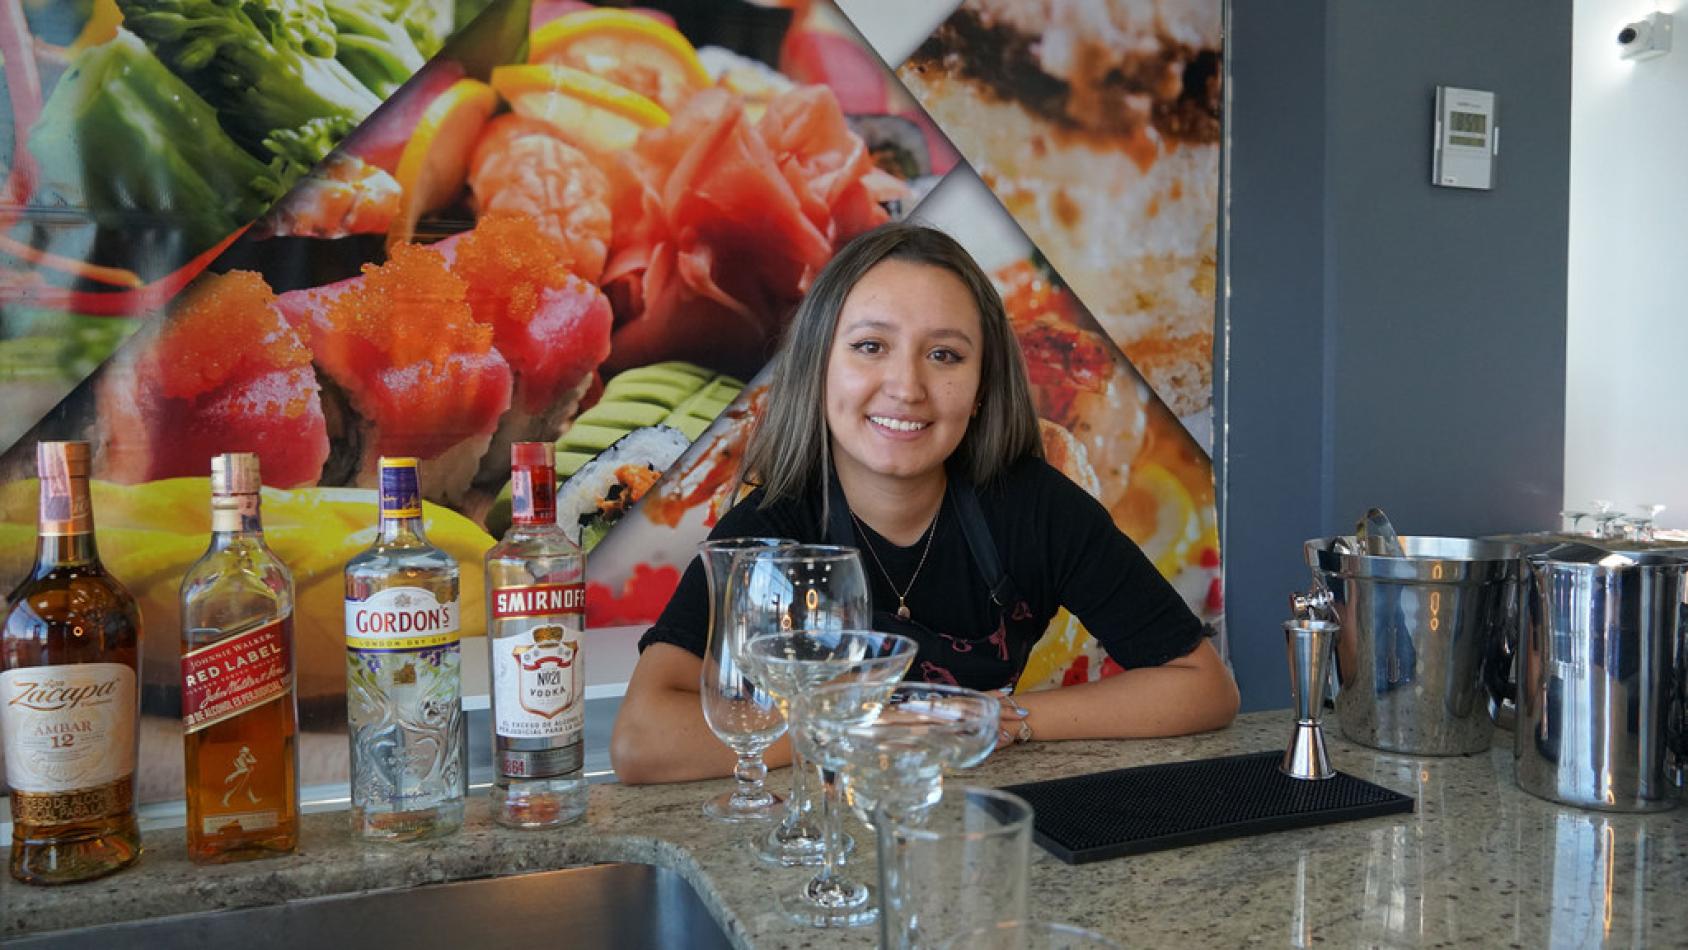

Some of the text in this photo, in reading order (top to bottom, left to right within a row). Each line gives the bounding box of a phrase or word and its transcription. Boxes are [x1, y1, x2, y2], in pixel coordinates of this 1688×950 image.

[355, 606, 449, 634] GORDON'S
[360, 636, 447, 648] LONDON DRY GIN
[186, 665, 220, 688] RED
[224, 642, 281, 673] LABEL
[191, 648, 232, 671] JOHNNIE
[8, 680, 118, 711] Zacapa
[530, 686, 566, 697] VODKA
[50, 734, 74, 749] 12
